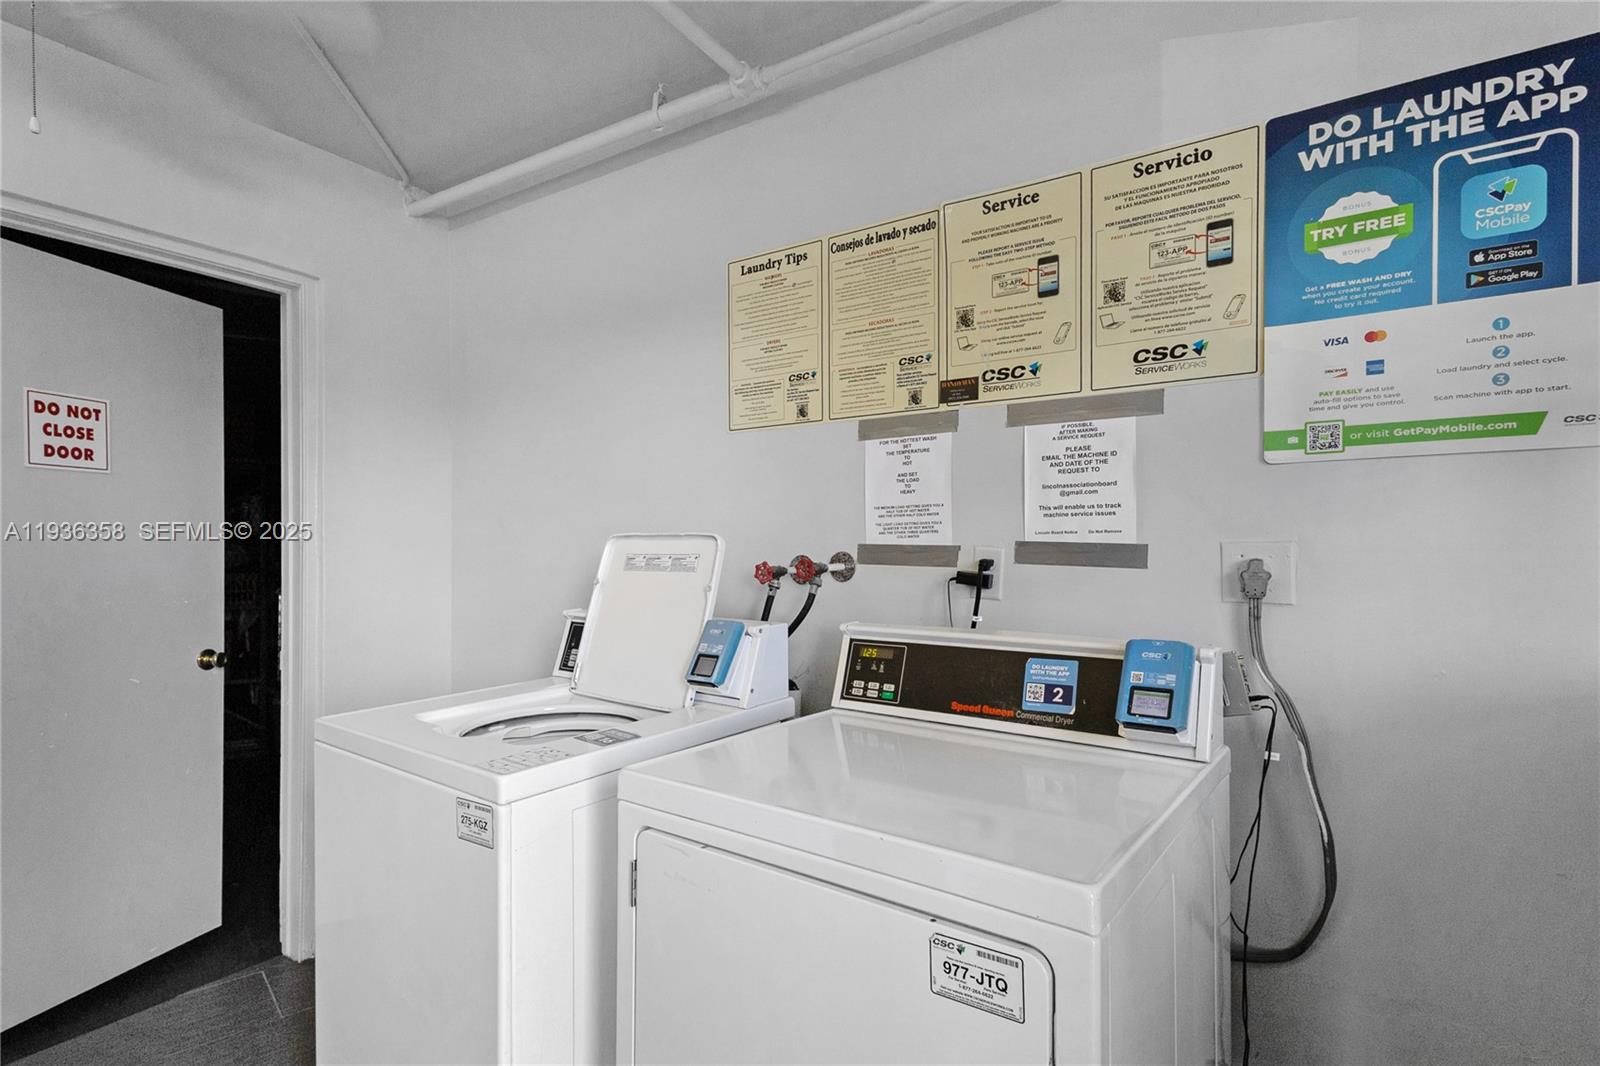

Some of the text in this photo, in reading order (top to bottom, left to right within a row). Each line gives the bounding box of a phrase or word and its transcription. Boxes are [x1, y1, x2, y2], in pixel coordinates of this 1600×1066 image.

[1308, 58, 1575, 146] DO LAUNDRY
[1297, 85, 1588, 172] WITH THE APP
[1133, 148, 1213, 178] Servicio
[1157, 176, 1192, 189] IMPORTANTE
[1211, 163, 1243, 175] NOSOTROS
[982, 192, 1040, 215] Service
[1342, 201, 1372, 211] BONUS
[1475, 202, 1532, 218] CSCPay
[1310, 213, 1406, 242] TRY FREE
[1475, 213, 1530, 231] Mobile
[831, 219, 936, 254] Consejos de lavado y secado
[1342, 247, 1371, 256] BONUS
[1487, 249, 1532, 262] App Store
[741, 252, 808, 276] Laundry Tips
[1382, 278, 1416, 288] account.
[1488, 270, 1539, 283] Google Play
[1327, 295, 1348, 303] credit
[1369, 287, 1402, 297] required
[1499, 319, 1503, 328] 1
[1324, 336, 1349, 346] VISA
[1466, 335, 1497, 343] Launch
[899, 355, 924, 365] CSC
[1133, 344, 1188, 363] CSC
[1497, 348, 1505, 356] 2
[1460, 364, 1491, 372] laundry
[1542, 355, 1568, 364] cycle.
[789, 372, 809, 381] CSC
[982, 365, 1026, 382] CSC
[1496, 374, 1505, 384] 3
[1313, 396, 1341, 405] auto-fill
[1343, 395, 1371, 403] options
[1456, 391, 1491, 399] machine
[34, 400, 102, 422] DO NOT
[1564, 415, 1596, 423] CSC
[42, 423, 95, 441] CLOSE
[1366, 430, 1390, 438] visit
[1393, 422, 1517, 436] GetPayMobile.com
[43, 444, 95, 462] DOOR
[1042, 480, 1117, 489] lincolnassociationboard
[1052, 688, 1063, 702] 2
[951, 701, 981, 712] Speed
[982, 705, 1014, 717] Queen
[1016, 710, 1054, 721] Commercial
[933, 938, 954, 949] CSC
[943, 961, 1008, 994] 977-JTQ
